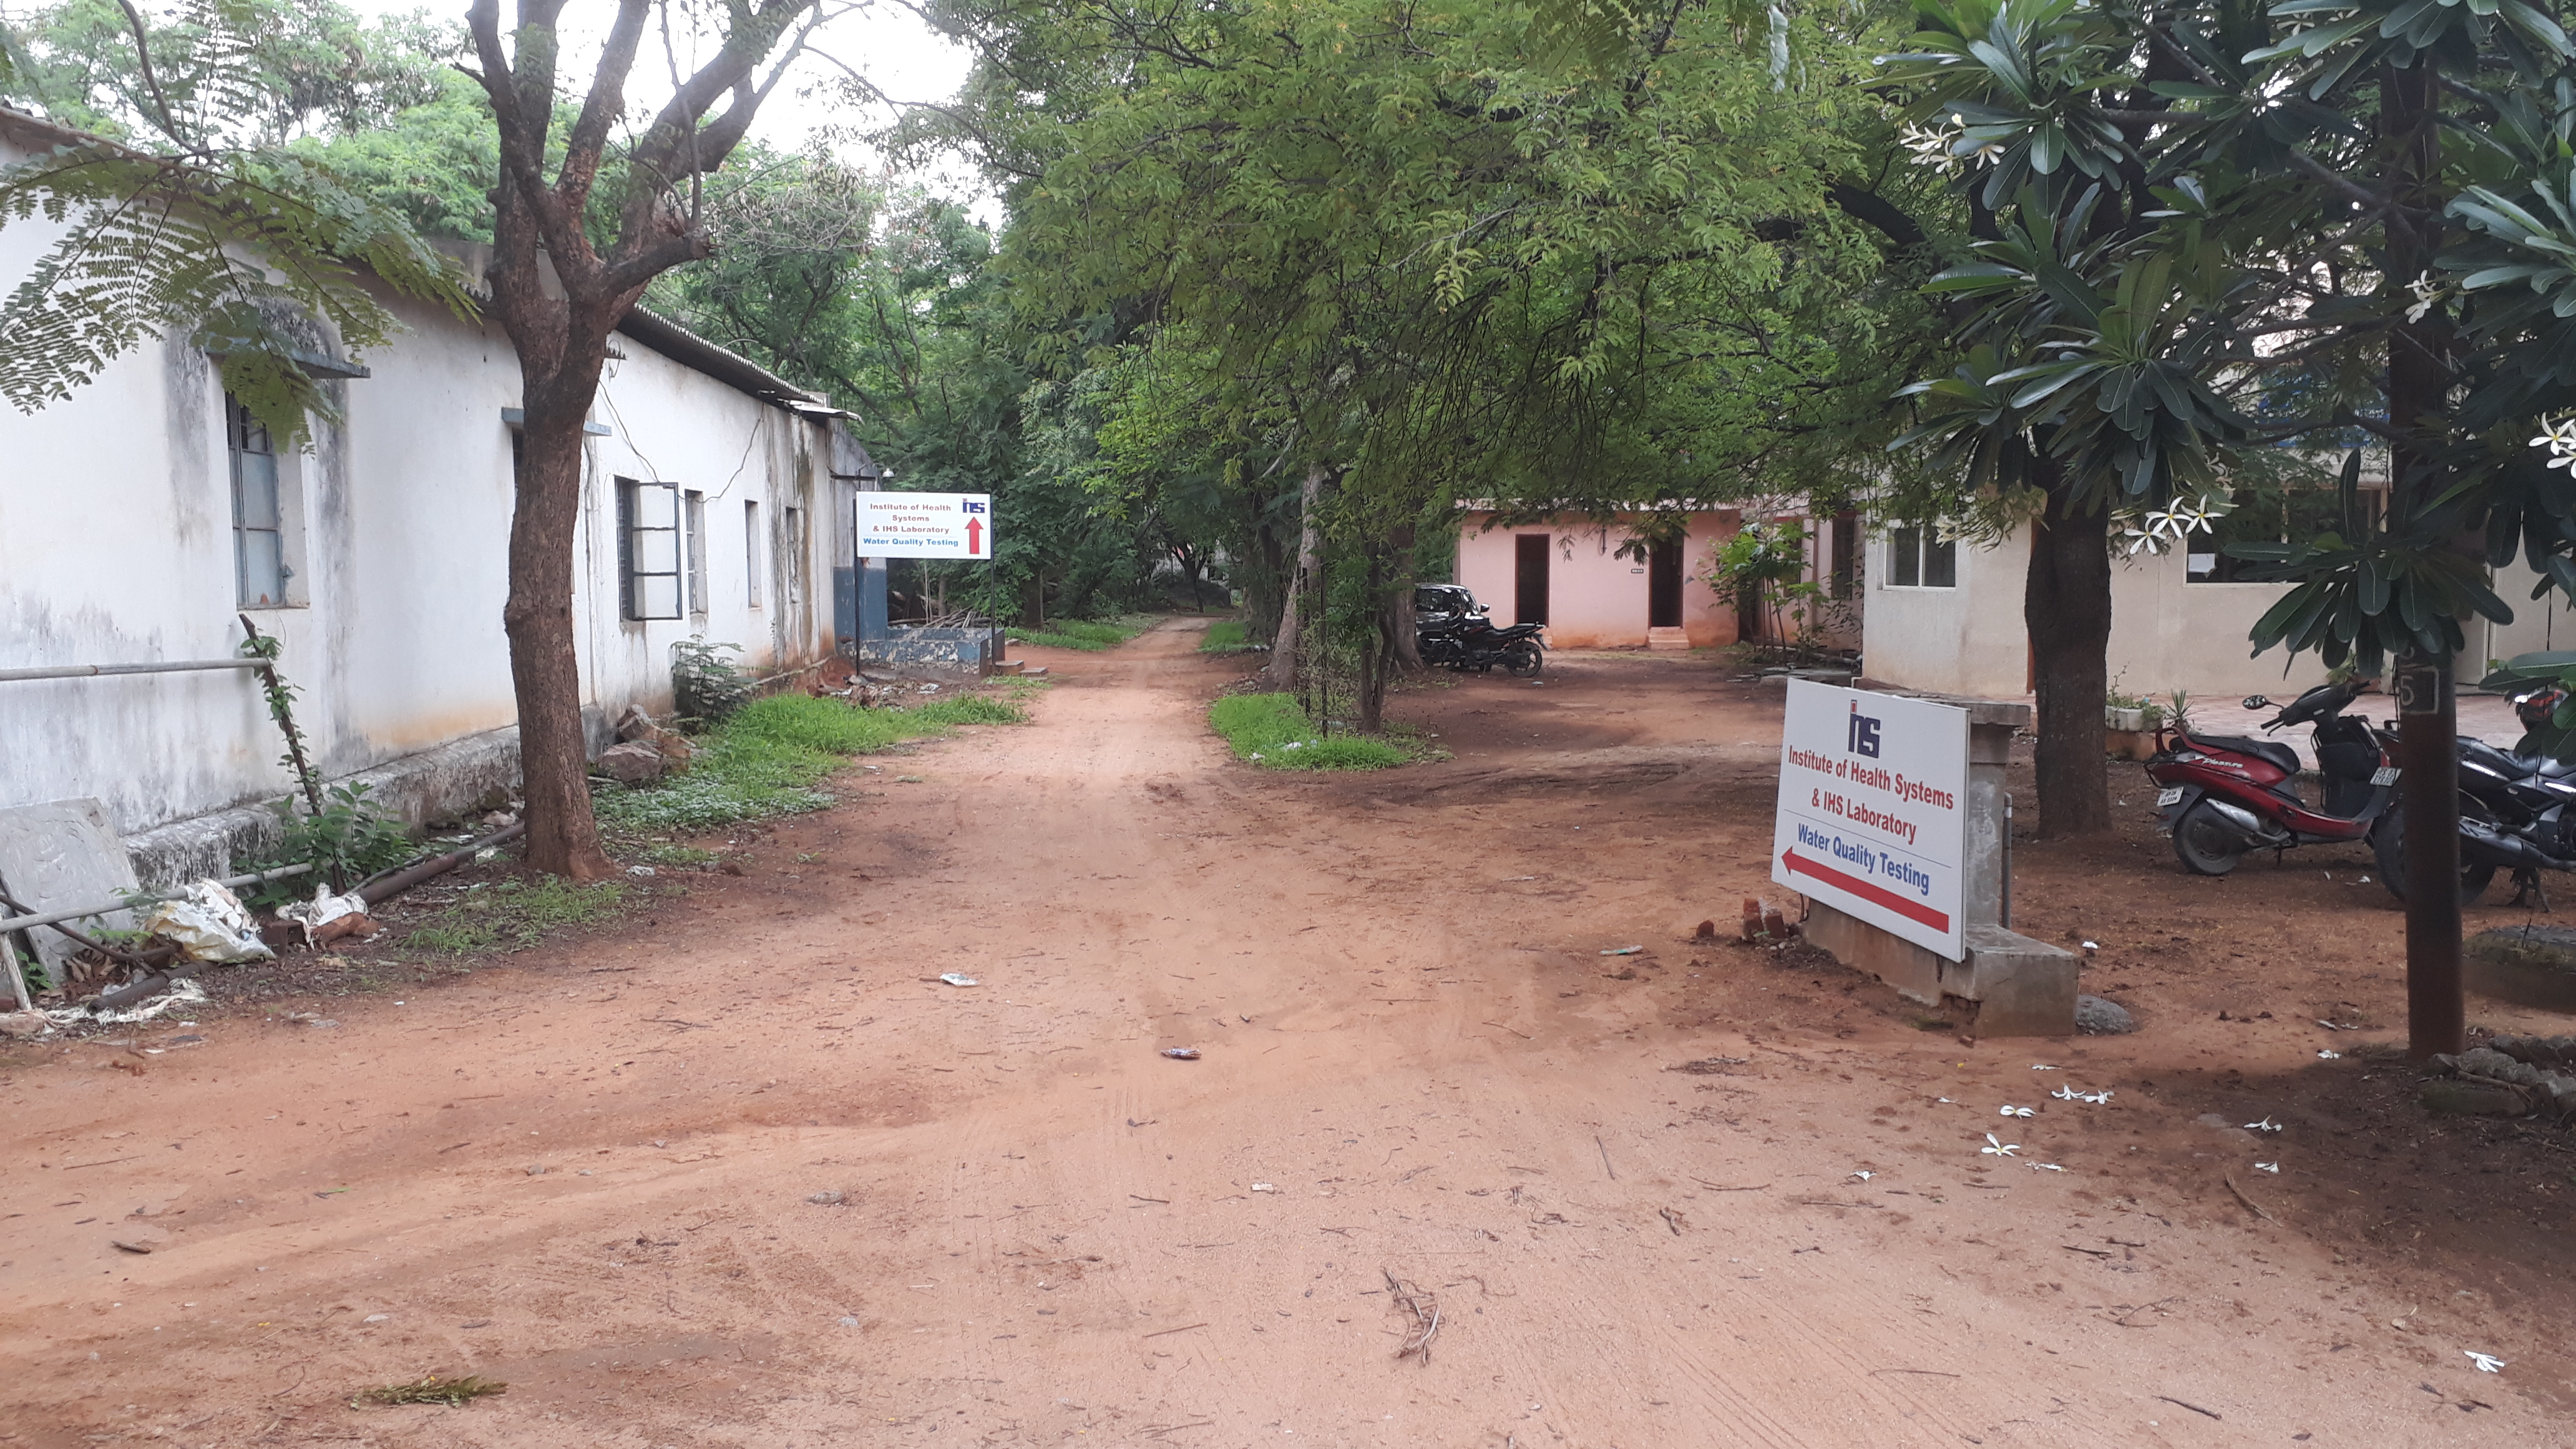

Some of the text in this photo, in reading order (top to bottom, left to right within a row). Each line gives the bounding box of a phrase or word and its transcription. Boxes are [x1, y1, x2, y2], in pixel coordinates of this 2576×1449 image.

[892, 539, 924, 547] Quality
[927, 539, 959, 547] Testing
[901, 526, 950, 534] Laboratory
[1788, 745, 1954, 810] Institute of Health Systems
[2202, 757, 2244, 769] Pleasure
[1812, 788, 1917, 845] & IHS Laboratory
[1798, 823, 1931, 895] Water Quality Testing
